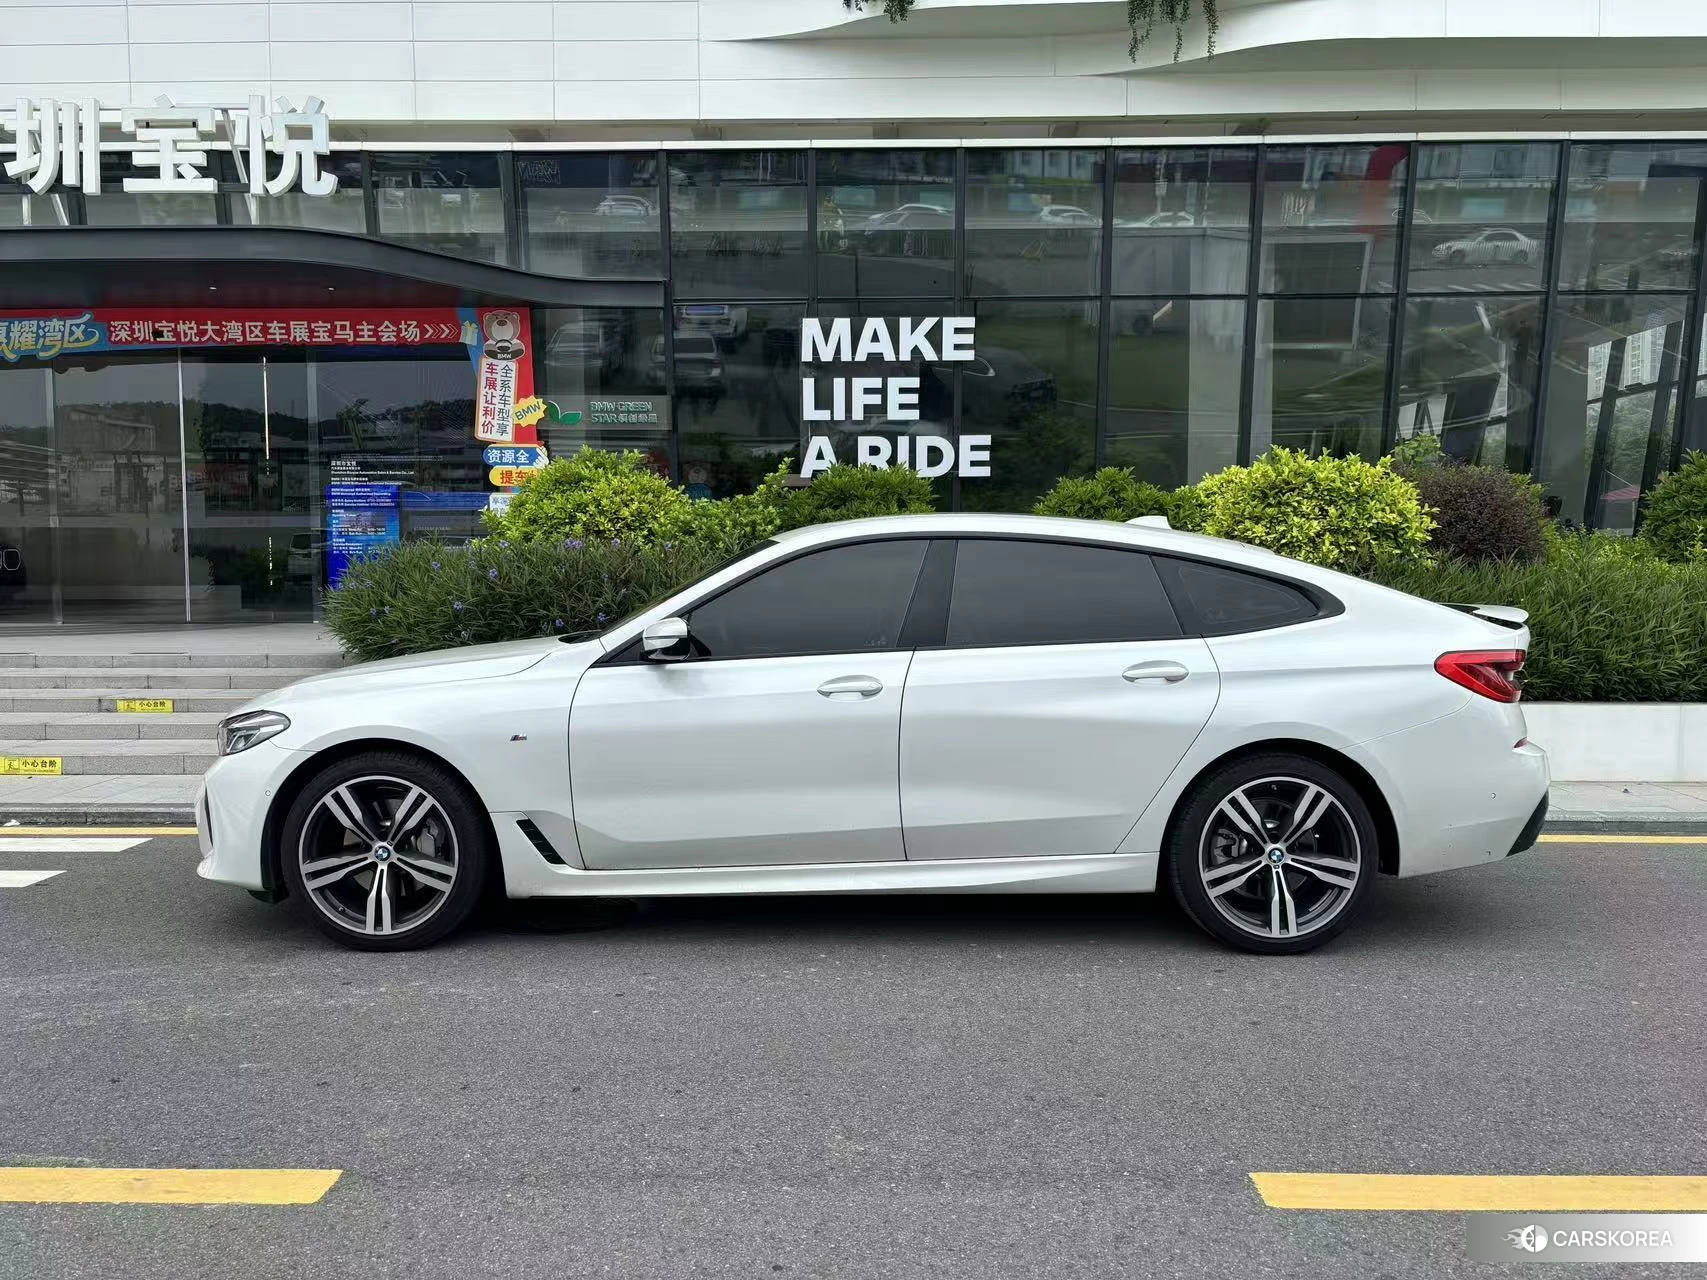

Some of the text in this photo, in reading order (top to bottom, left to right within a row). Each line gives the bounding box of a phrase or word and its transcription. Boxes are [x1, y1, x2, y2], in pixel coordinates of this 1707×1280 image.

[4, 94, 338, 197] 圳宝悦
[109, 320, 421, 343] 深圳宝悦大湾区车展宝马主会场
[801, 316, 976, 362] MAKE
[481, 361, 499, 436] 车展让利价
[496, 364, 513, 437] 全系车型享
[514, 400, 542, 421] BMW
[590, 401, 653, 412] BMW GREEN
[802, 377, 921, 421] LIFE
[800, 434, 992, 478] A RIDE
[138, 700, 166, 708] 小心台阶
[22, 759, 57, 769] 小心台阶
